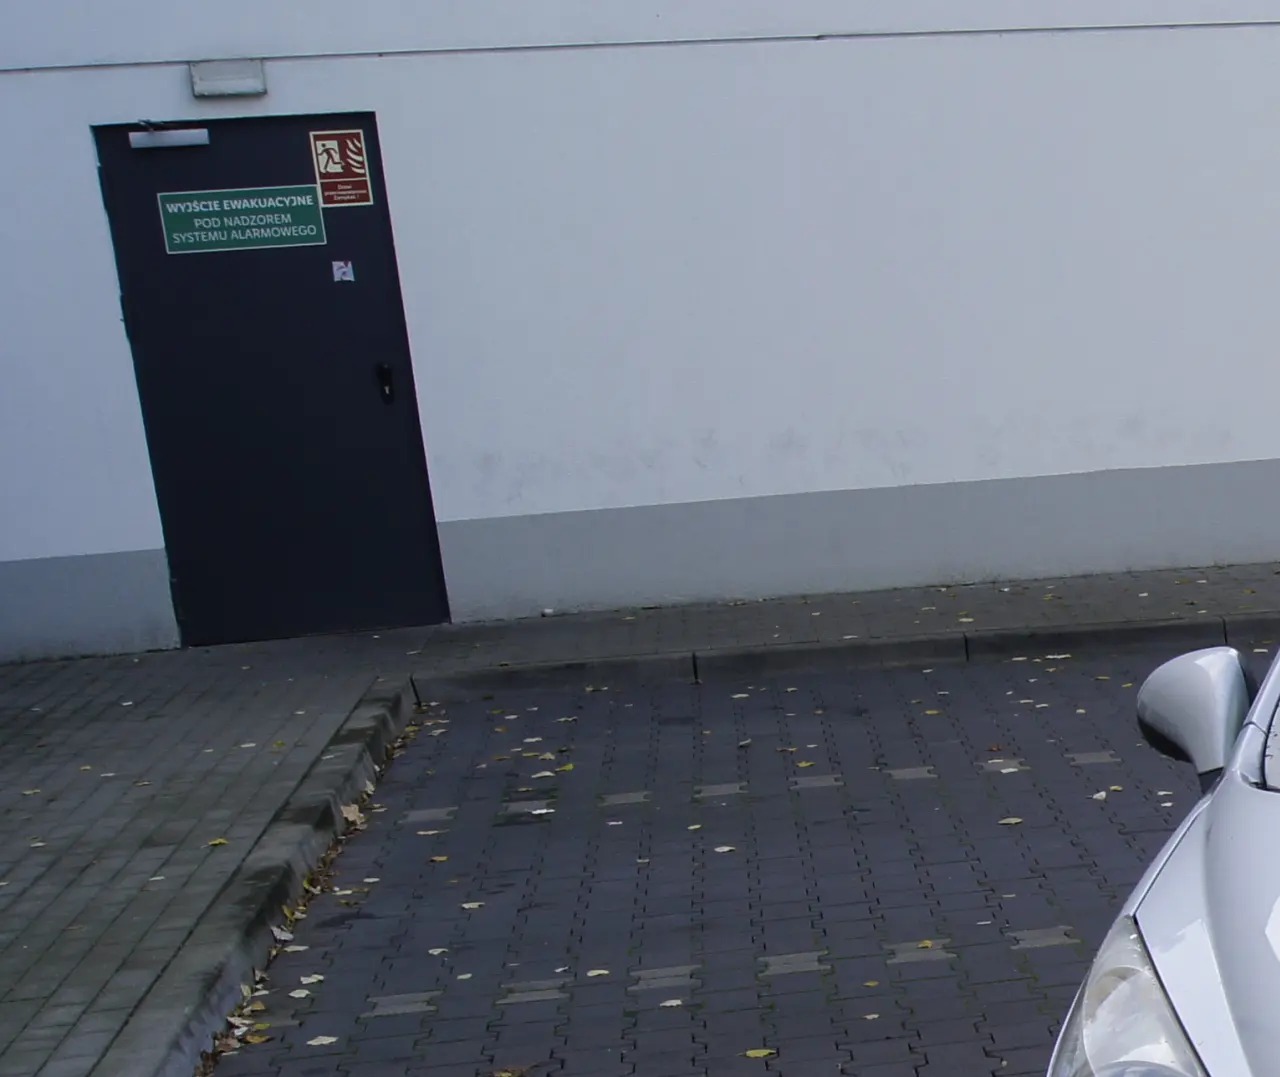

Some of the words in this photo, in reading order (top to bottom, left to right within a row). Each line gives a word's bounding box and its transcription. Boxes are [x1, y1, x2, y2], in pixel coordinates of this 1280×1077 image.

[166, 200, 221, 213] WYJŚCIE
[223, 195, 314, 210] EWAKUACYJNE
[194, 217, 221, 229] POD
[223, 214, 292, 227] NADZOREM
[172, 231, 228, 244] SYSTEMU
[230, 225, 317, 240] ALARMOWEGO
